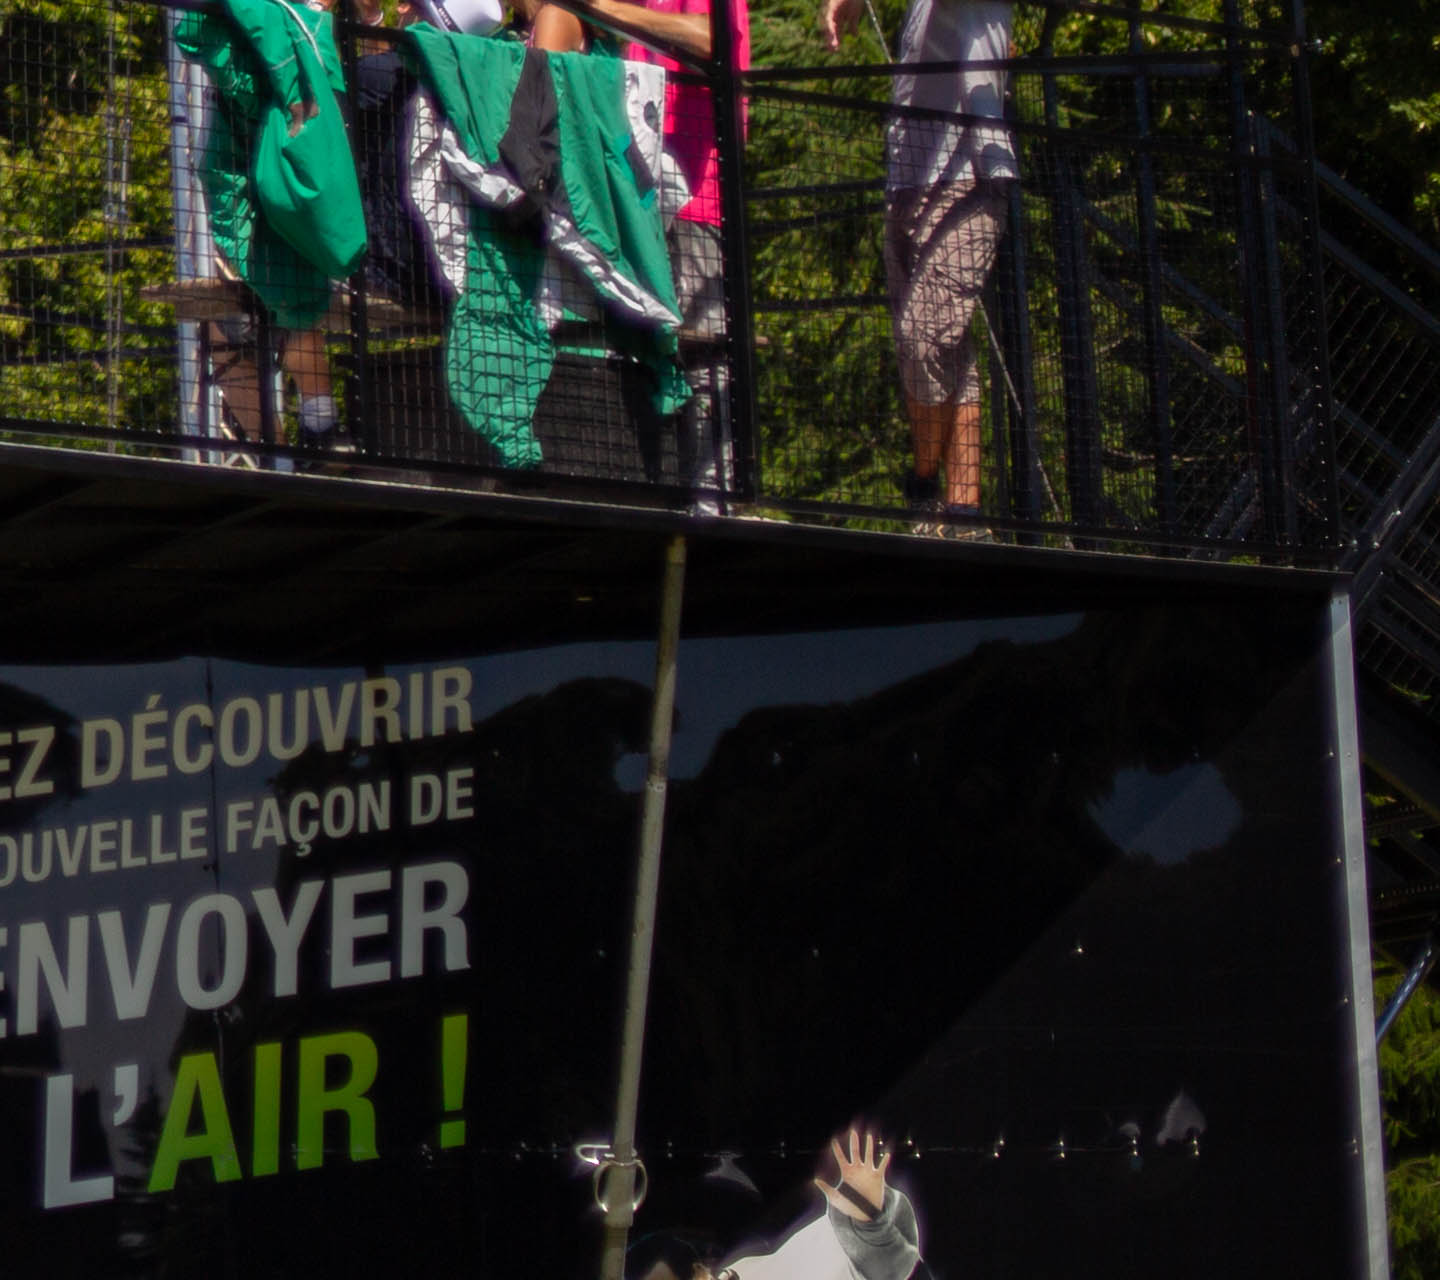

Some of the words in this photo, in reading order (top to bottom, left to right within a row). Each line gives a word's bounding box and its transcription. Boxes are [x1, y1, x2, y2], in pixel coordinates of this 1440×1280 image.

[80, 666, 474, 789] DÉCOUVRIR
[225, 781, 391, 858] FAÇON
[410, 768, 475, 826] DE
[42, 1030, 379, 1210] L'AIR
